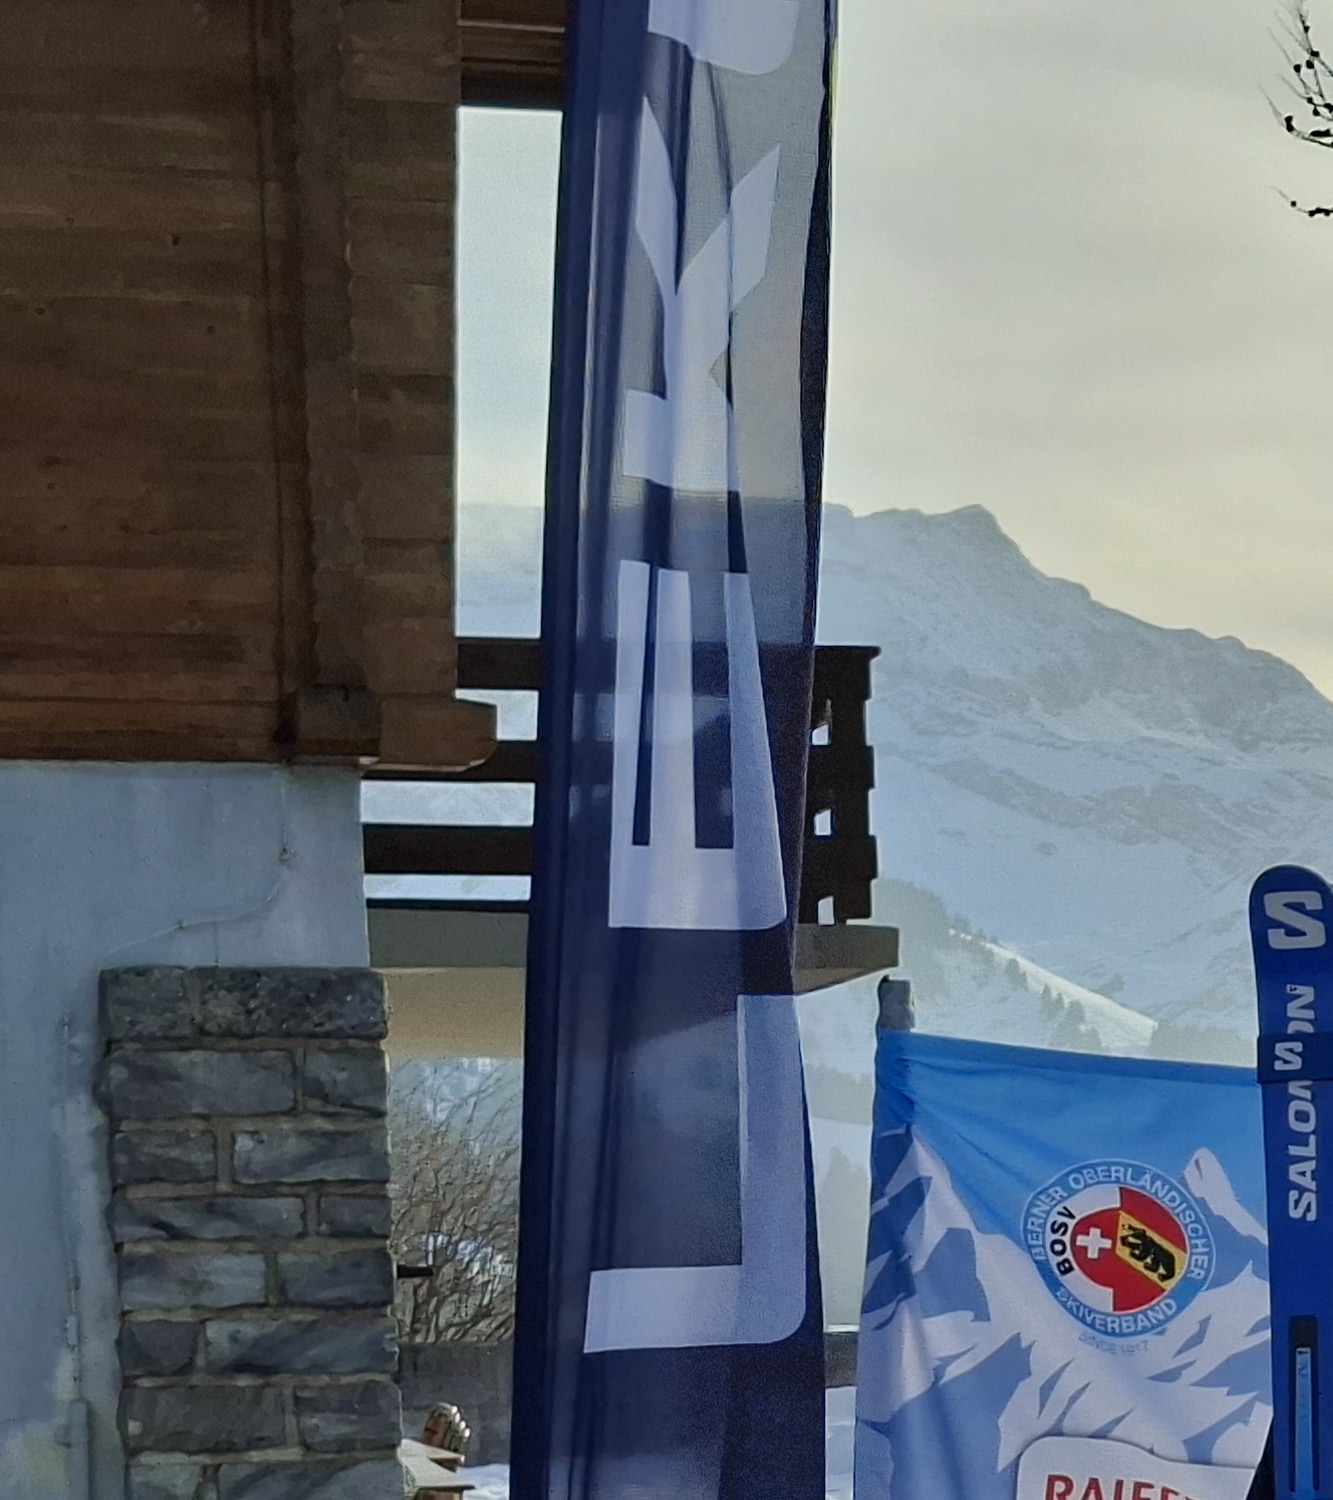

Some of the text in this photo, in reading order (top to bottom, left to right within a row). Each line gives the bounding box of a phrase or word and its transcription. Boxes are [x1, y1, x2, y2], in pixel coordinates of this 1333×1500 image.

[1028, 1185, 1068, 1260] BERNER
[1050, 1206, 1076, 1276] BOSV
[1056, 1287, 1177, 1333] SKIVERBAND
